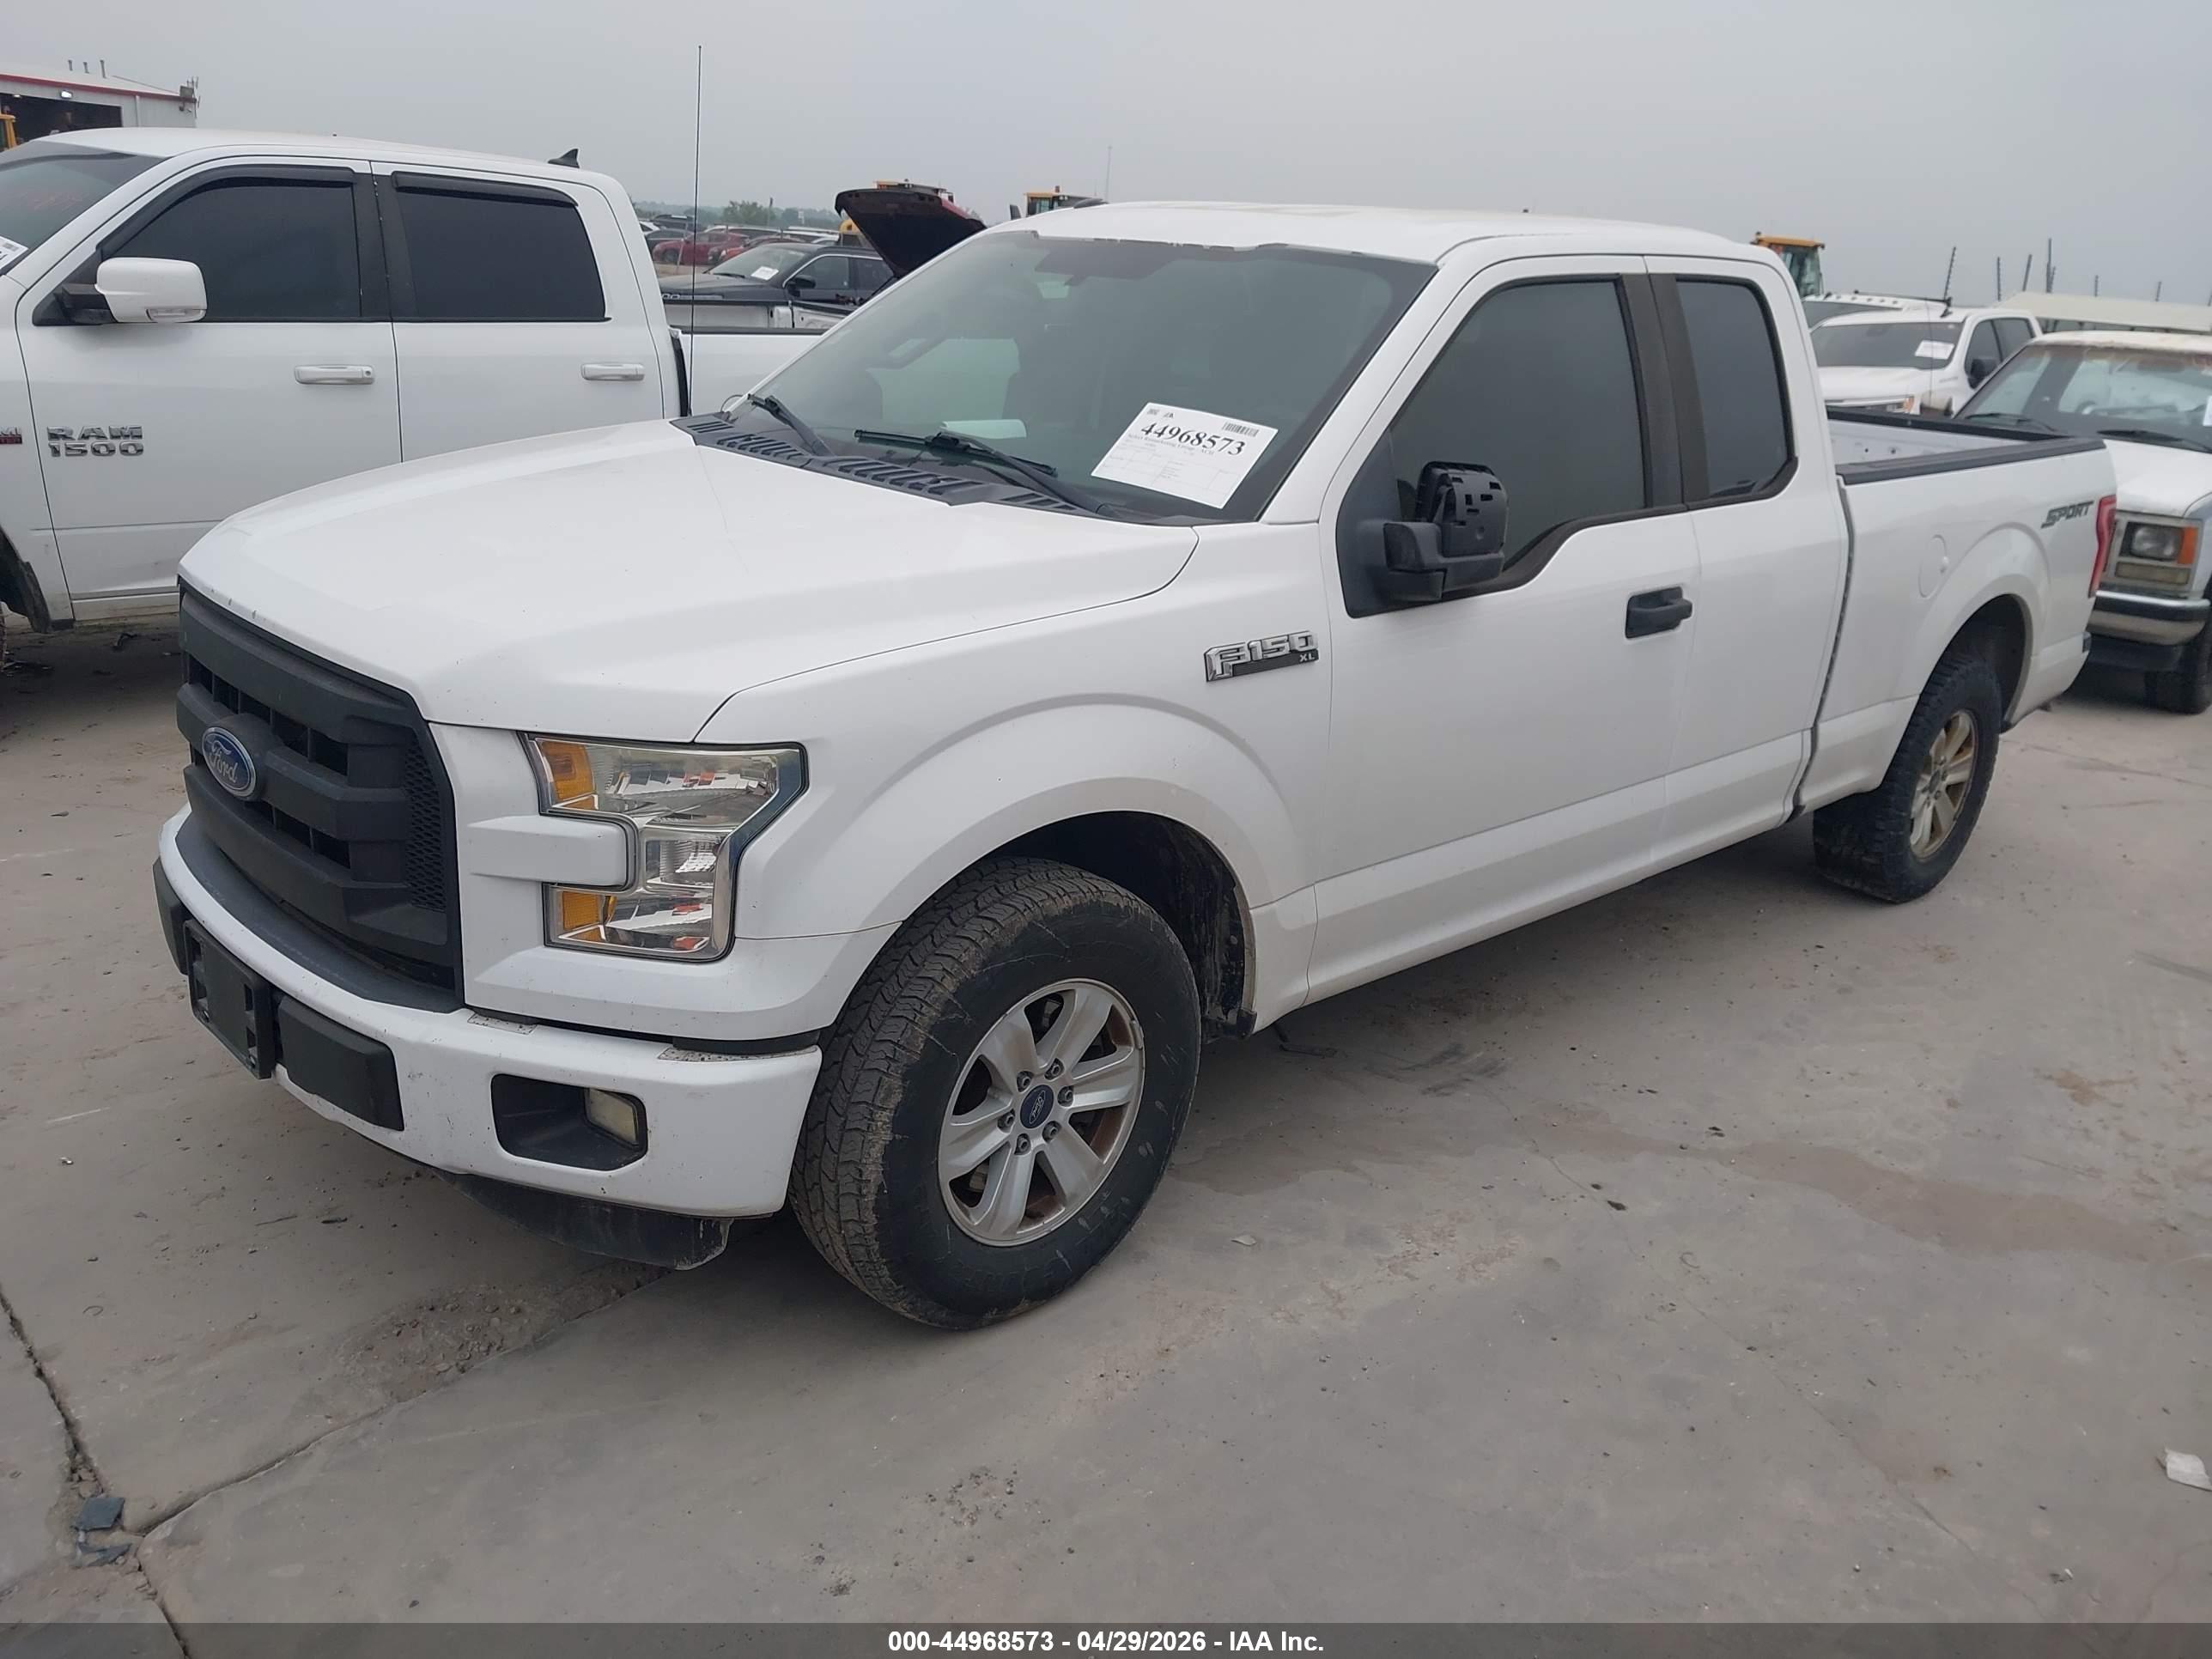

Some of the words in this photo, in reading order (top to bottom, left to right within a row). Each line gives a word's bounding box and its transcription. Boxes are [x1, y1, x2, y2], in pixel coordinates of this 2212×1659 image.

[46, 425, 143, 441] RAM
[1140, 422, 1247, 456] 44968573
[47, 441, 144, 458] 1500
[2040, 501, 2094, 529] SPORT
[1298, 653, 1316, 663] XL
